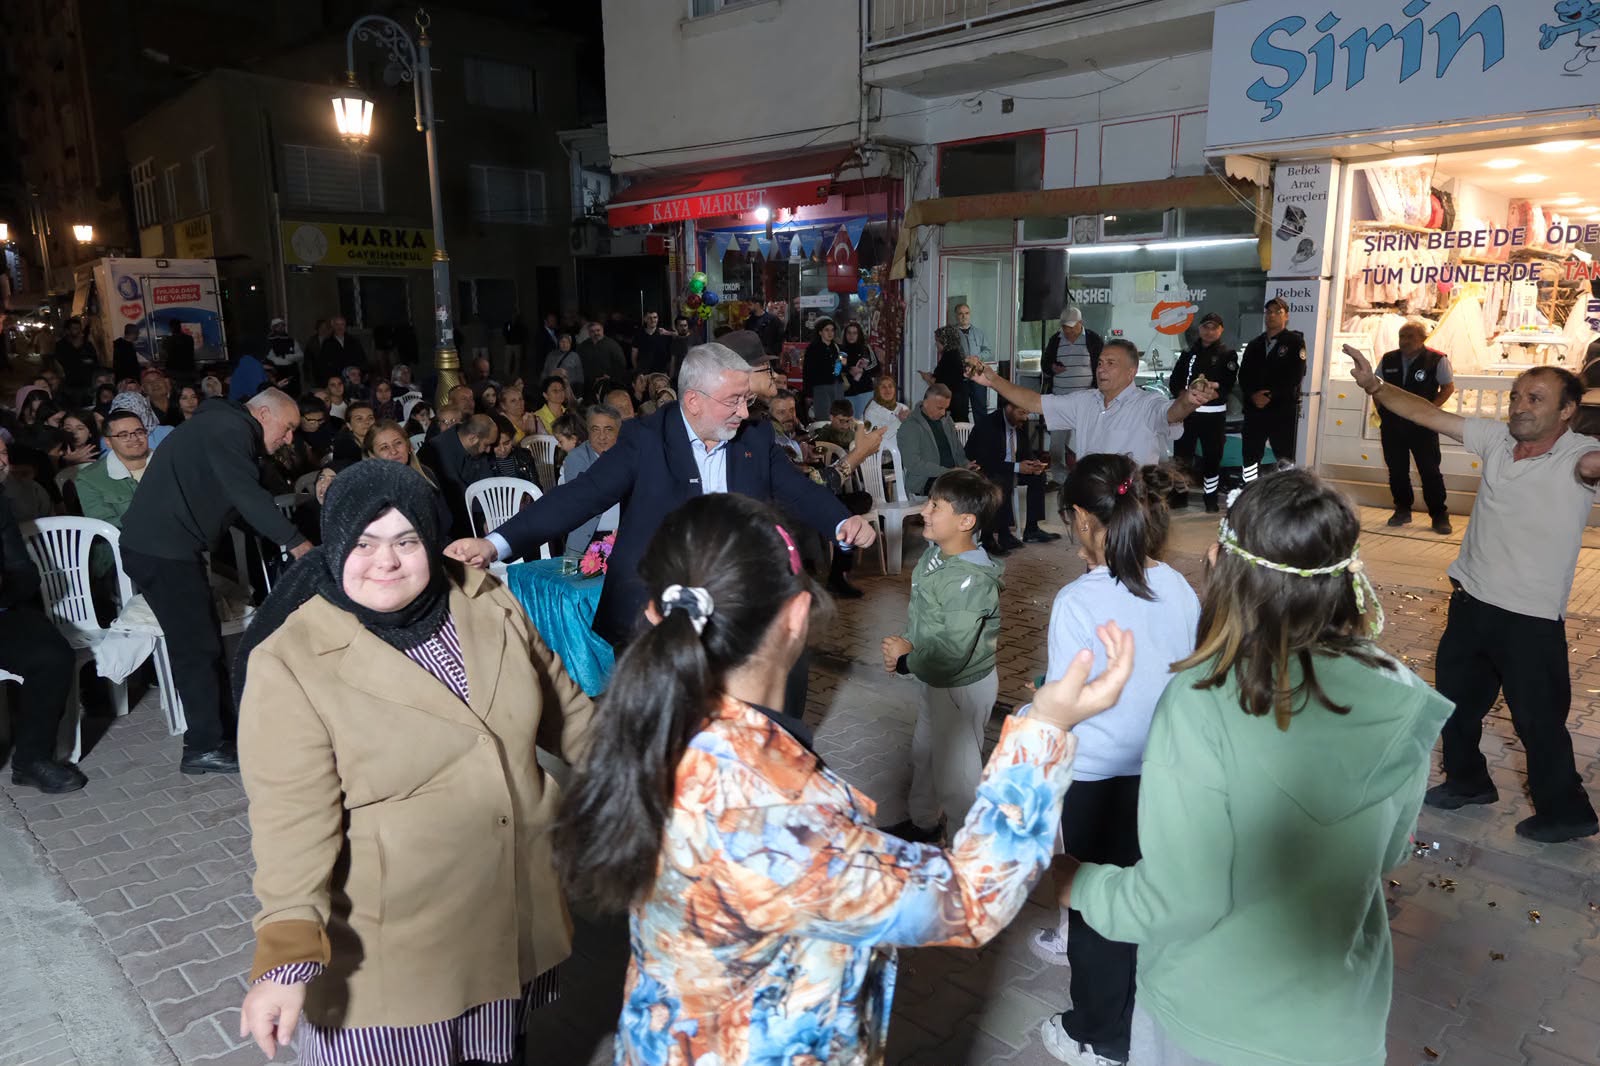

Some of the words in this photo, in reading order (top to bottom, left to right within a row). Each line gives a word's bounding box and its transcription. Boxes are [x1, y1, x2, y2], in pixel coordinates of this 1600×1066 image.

[1246, 0, 1505, 122] Şirin
[1287, 164, 1320, 177] Bebek
[1291, 180, 1316, 190] Araç
[653, 200, 691, 221] KAYA
[698, 189, 767, 215] MARKET
[1277, 191, 1328, 203] Gereçleri
[339, 226, 426, 248] MARKA
[1364, 231, 1420, 256] ŞİRİN
[1362, 264, 1403, 285] TÜM
[1410, 262, 1542, 284] ÜRÜNLERDE
[1275, 287, 1312, 298] Bebek
